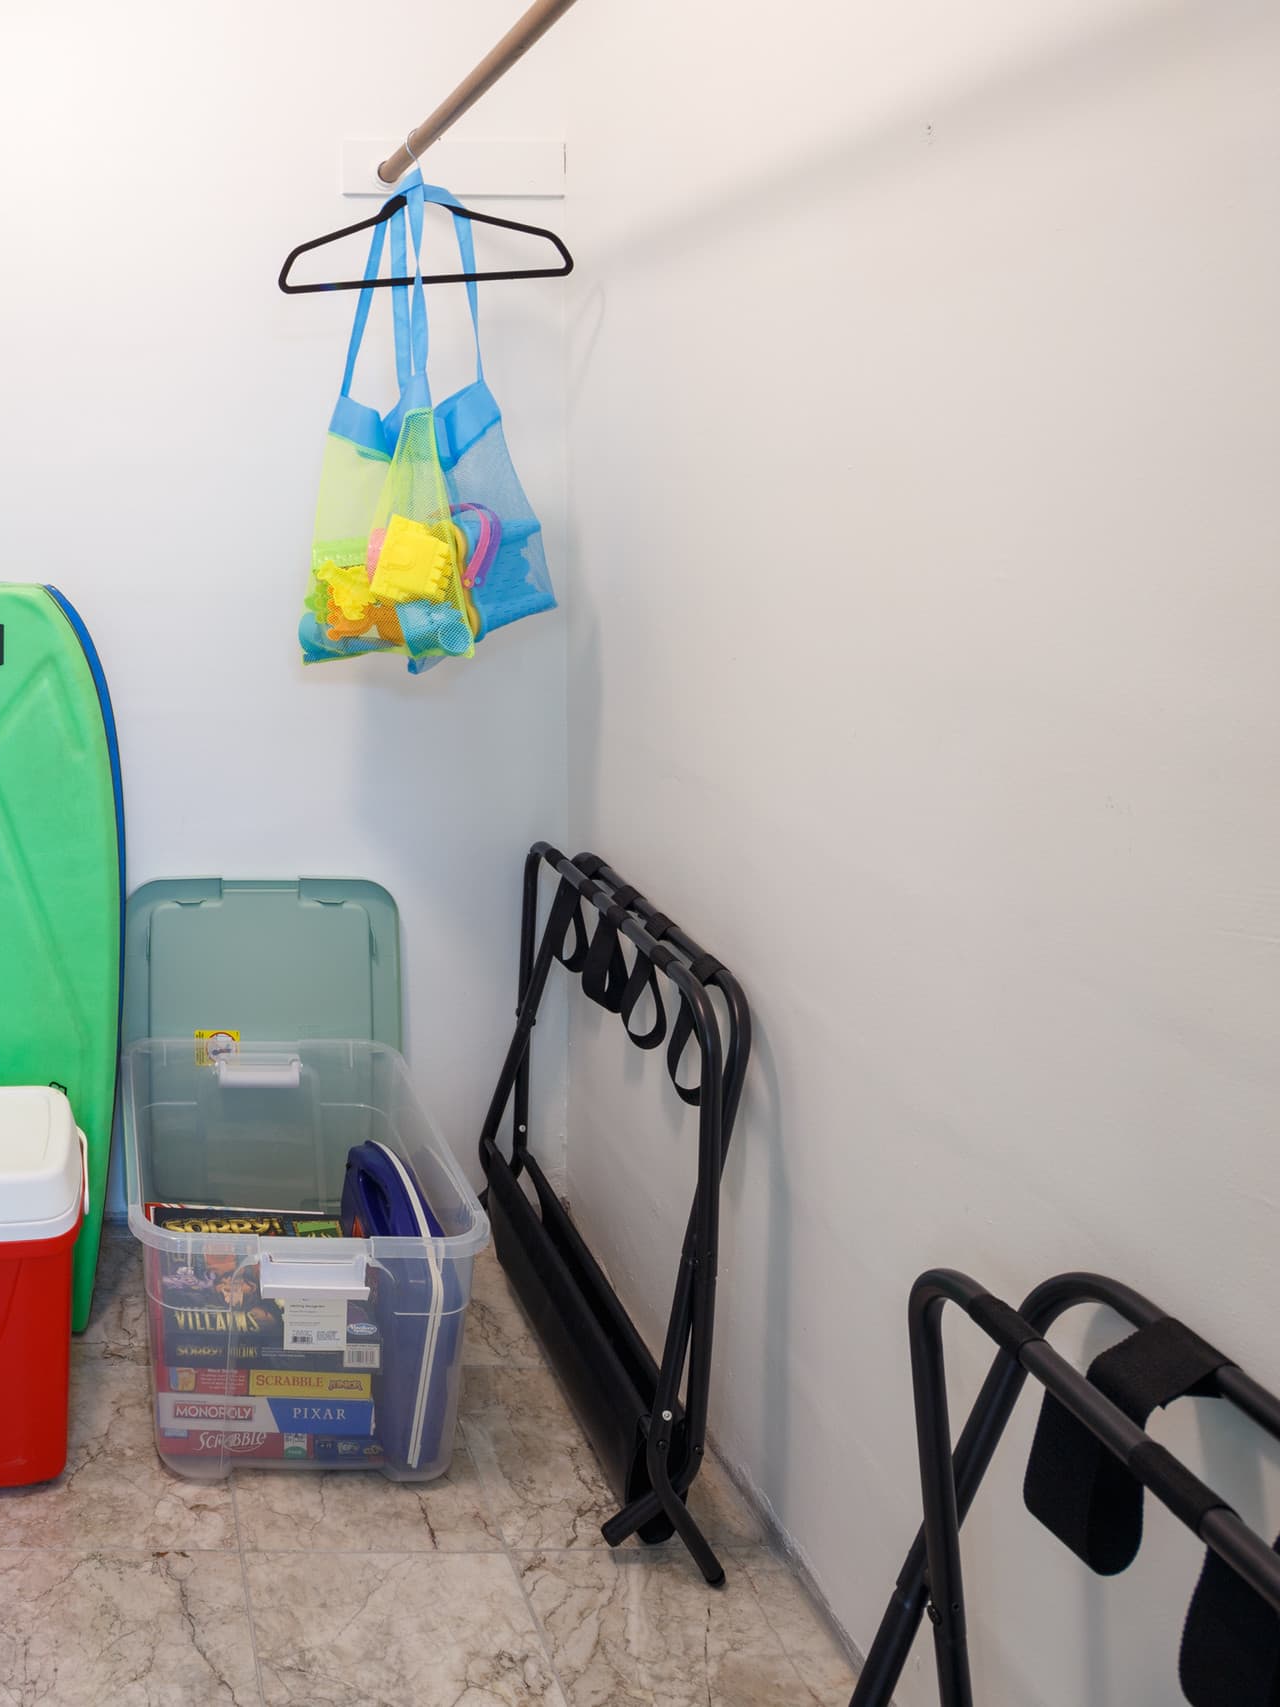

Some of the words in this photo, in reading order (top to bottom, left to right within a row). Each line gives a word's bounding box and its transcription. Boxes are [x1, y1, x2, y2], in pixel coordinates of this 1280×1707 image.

[175, 1307, 260, 1332] VILLAINS
[255, 1374, 324, 1388] SCRABBLE
[175, 1406, 252, 1420] MONOPOLY
[292, 1407, 346, 1420] PIXAR
